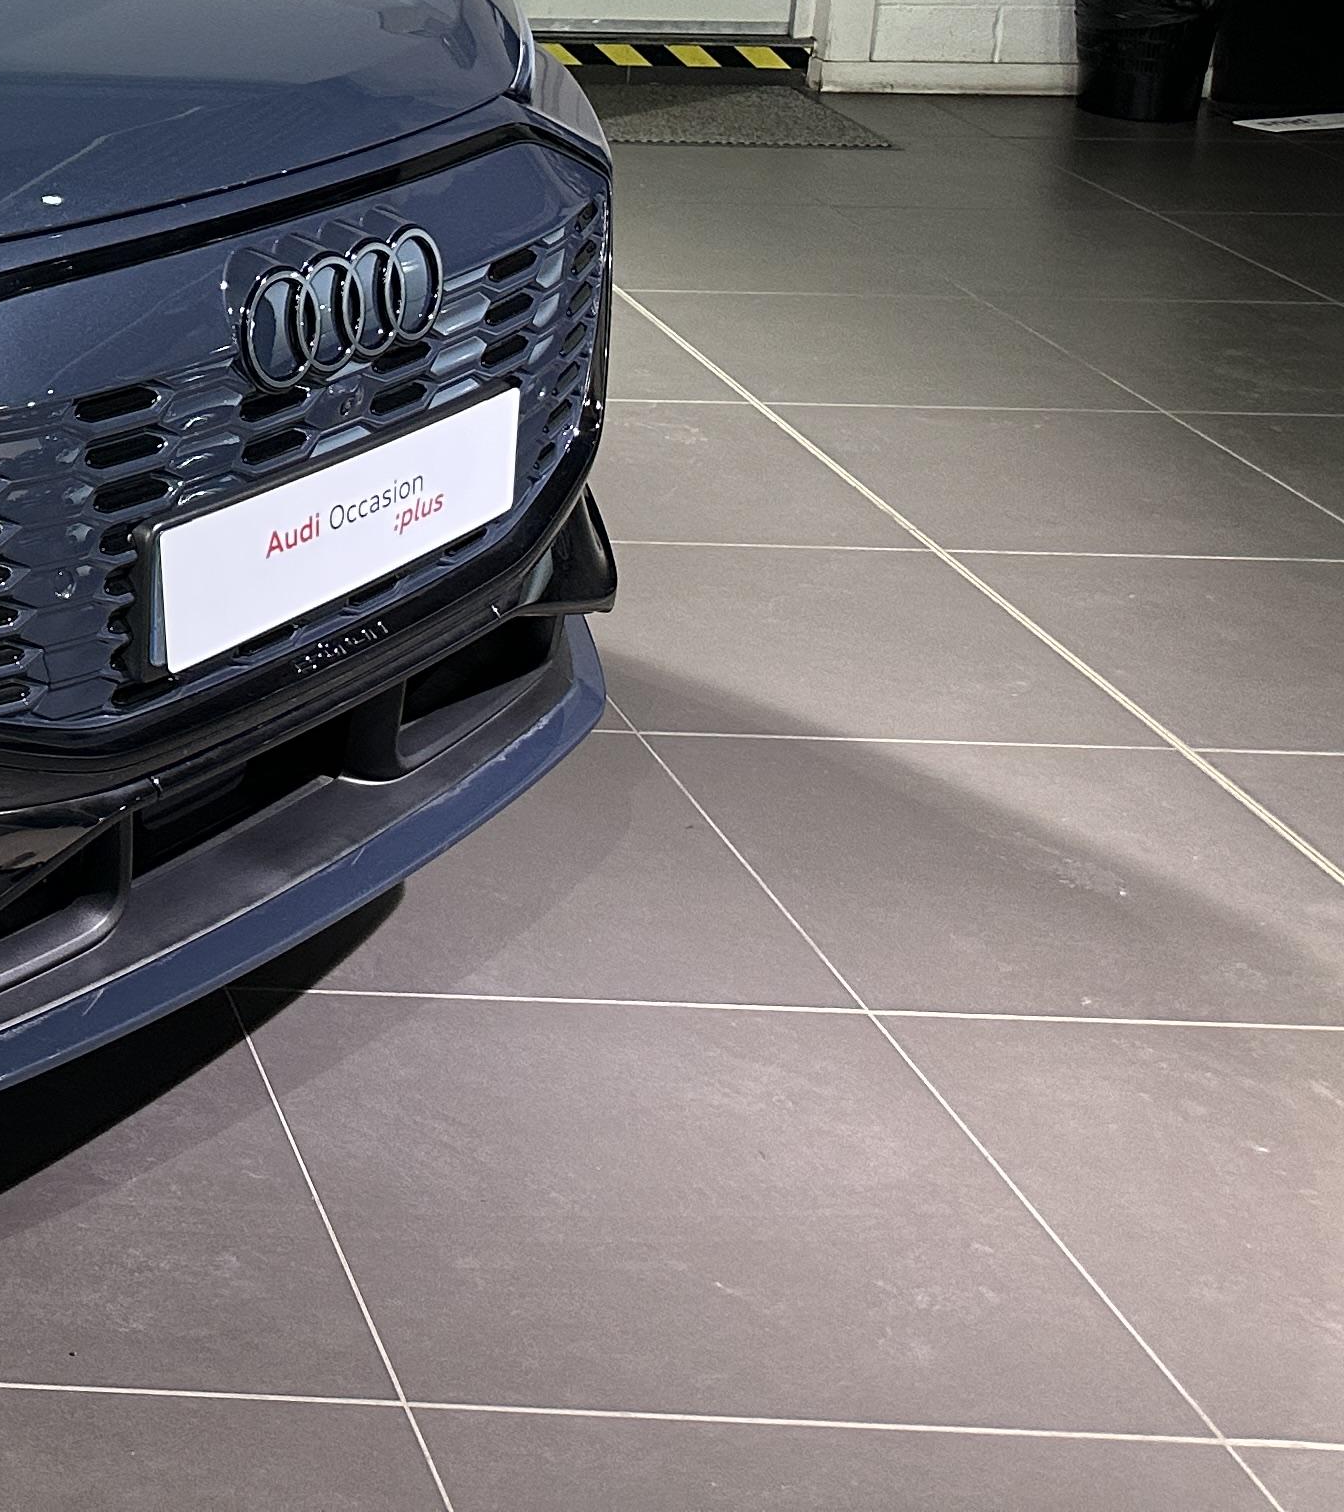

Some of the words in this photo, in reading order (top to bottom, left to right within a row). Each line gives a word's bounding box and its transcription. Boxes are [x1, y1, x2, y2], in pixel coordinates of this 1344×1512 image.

[266, 512, 321, 559] Audi
[329, 475, 424, 530] Occasion
[393, 493, 445, 536] :plus
